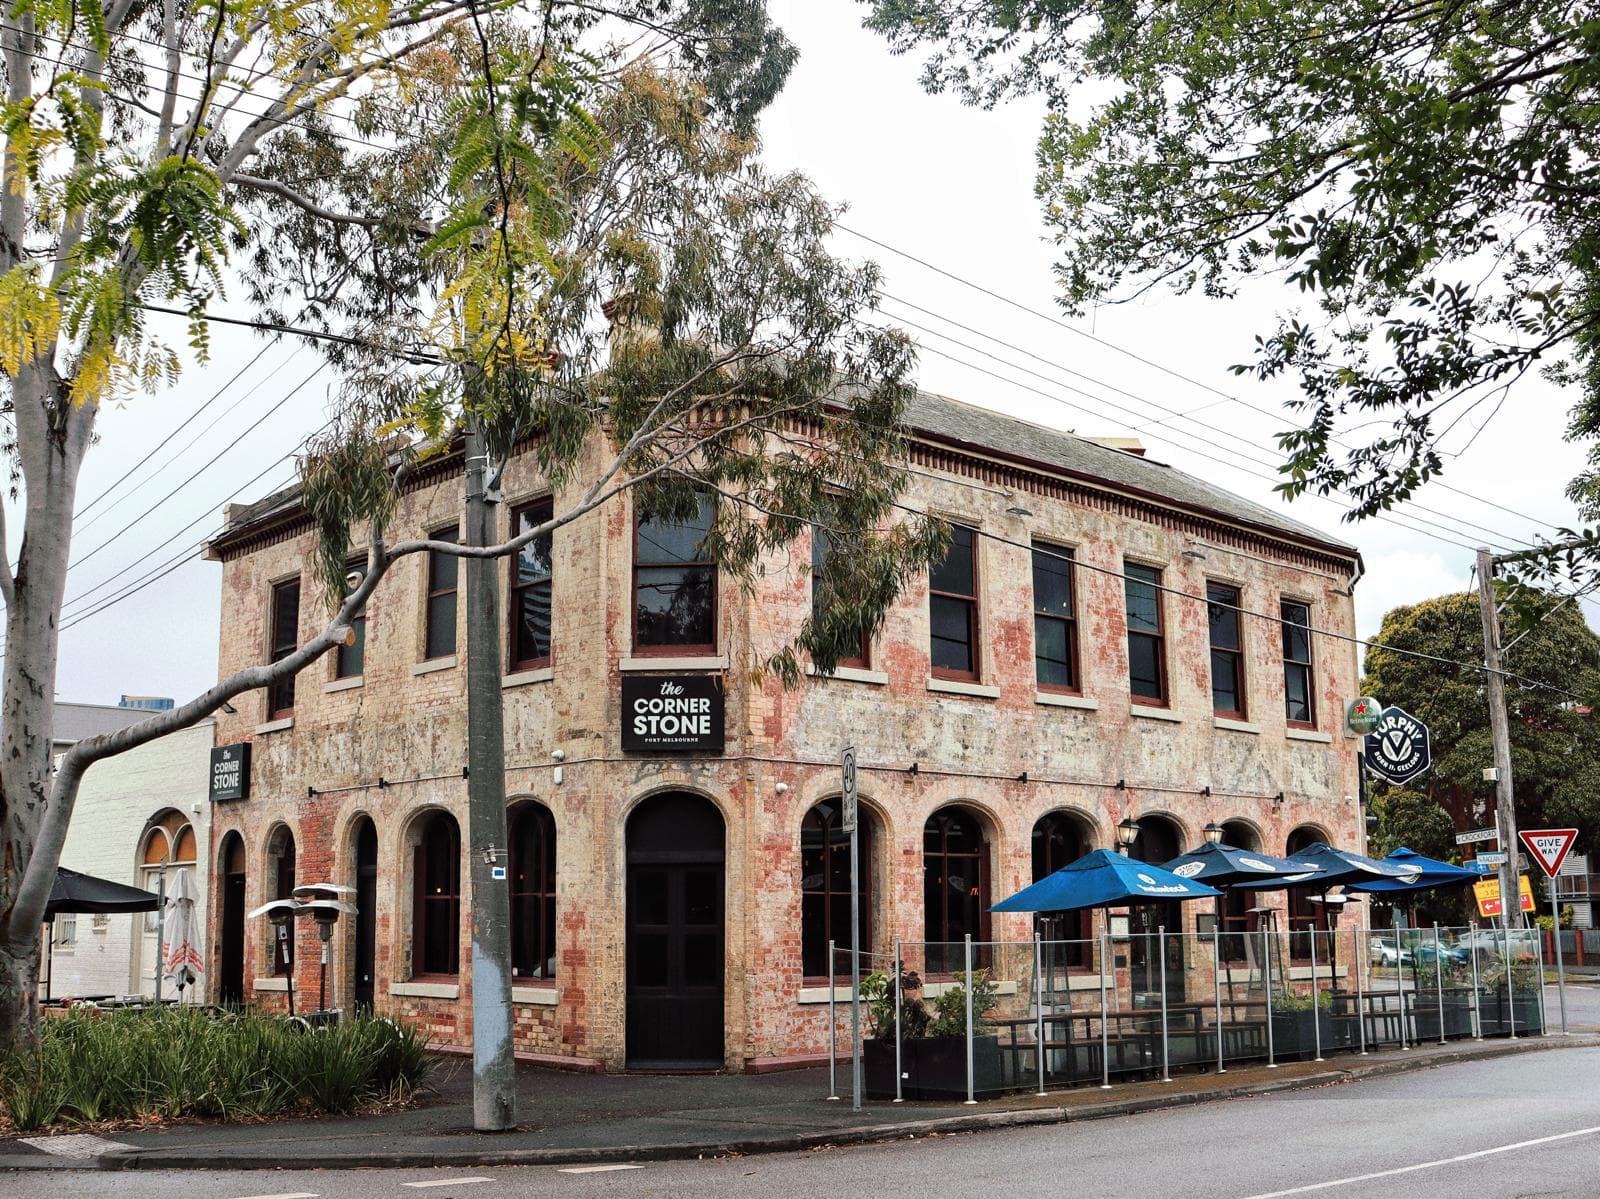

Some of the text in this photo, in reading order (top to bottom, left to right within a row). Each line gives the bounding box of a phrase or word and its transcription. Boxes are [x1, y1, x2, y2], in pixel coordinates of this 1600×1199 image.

[660, 681, 684, 696] the
[633, 698, 711, 714] CORNER
[633, 715, 711, 735] STONE
[214, 760, 239, 774] CORNER
[1374, 751, 1389, 768] BORN
[1397, 752, 1421, 772] GEELONG
[213, 772, 239, 789] STONE
[844, 763, 854, 783] 40
[1537, 838, 1561, 847] GIVE
